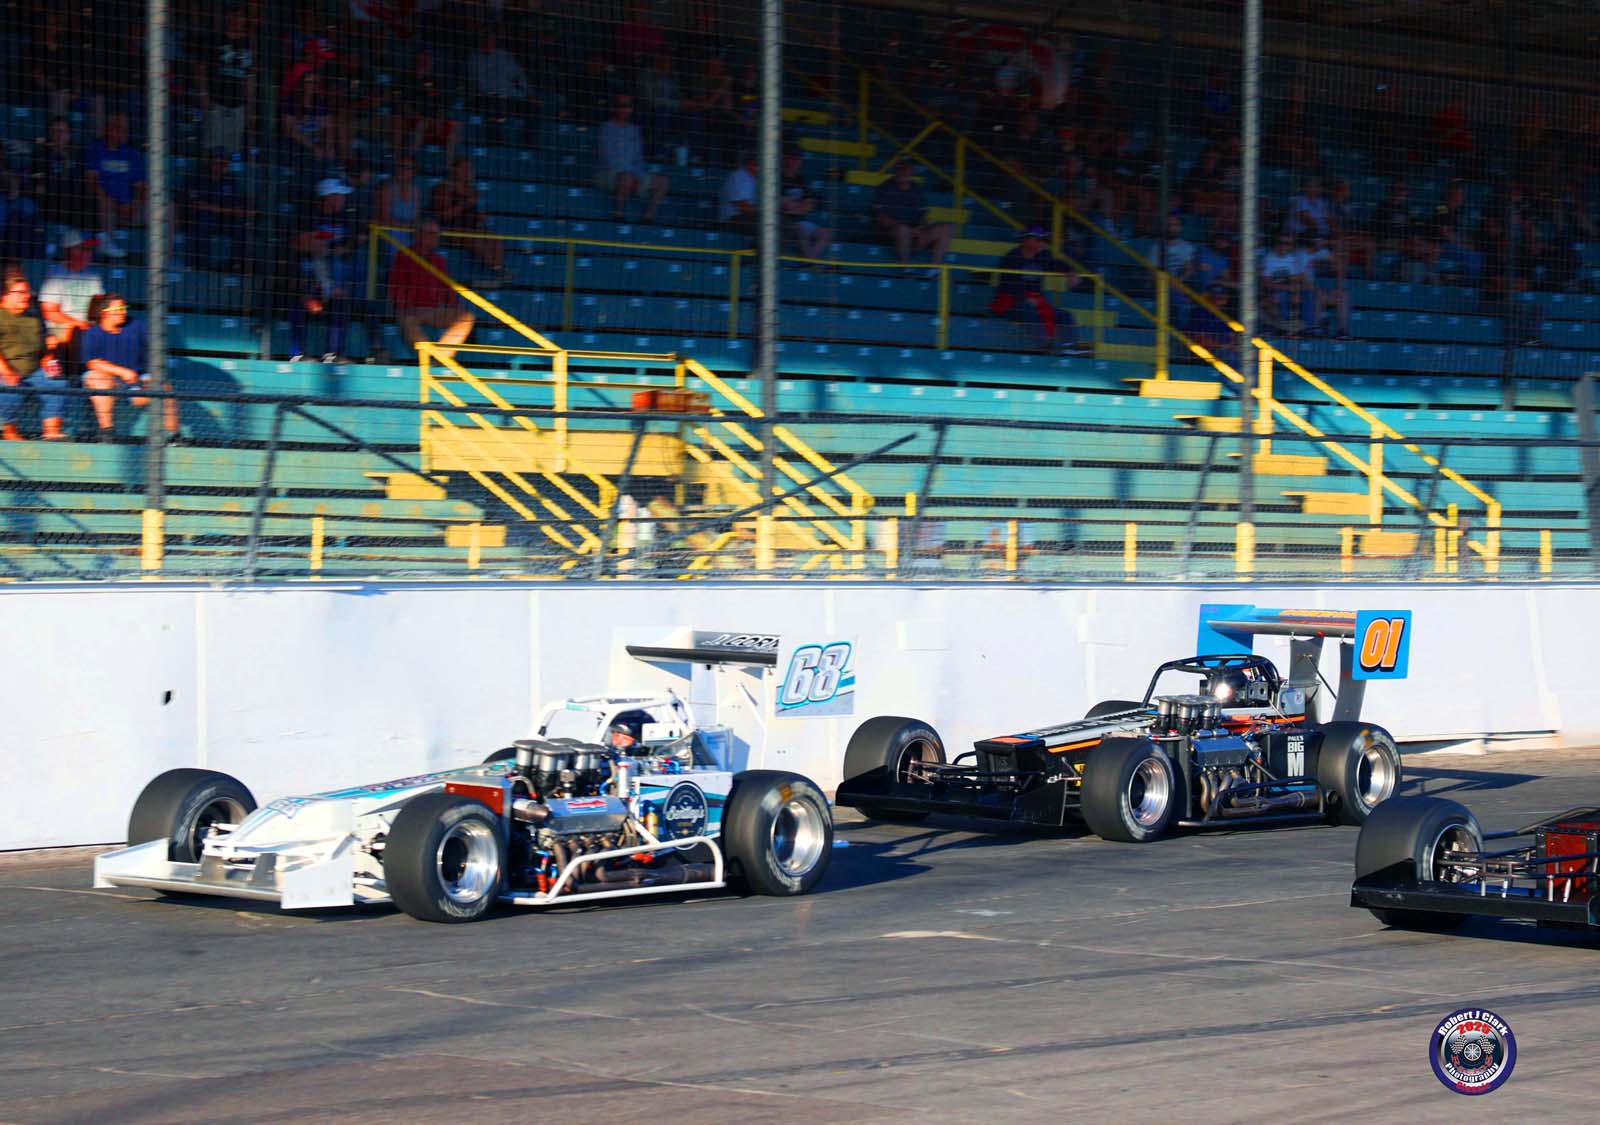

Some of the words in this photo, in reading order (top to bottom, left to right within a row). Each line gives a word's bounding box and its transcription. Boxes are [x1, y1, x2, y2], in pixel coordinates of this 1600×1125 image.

[1360, 617, 1405, 671] 01
[780, 641, 852, 707] 68
[1287, 742, 1304, 752] BIG
[1287, 752, 1304, 776] M
